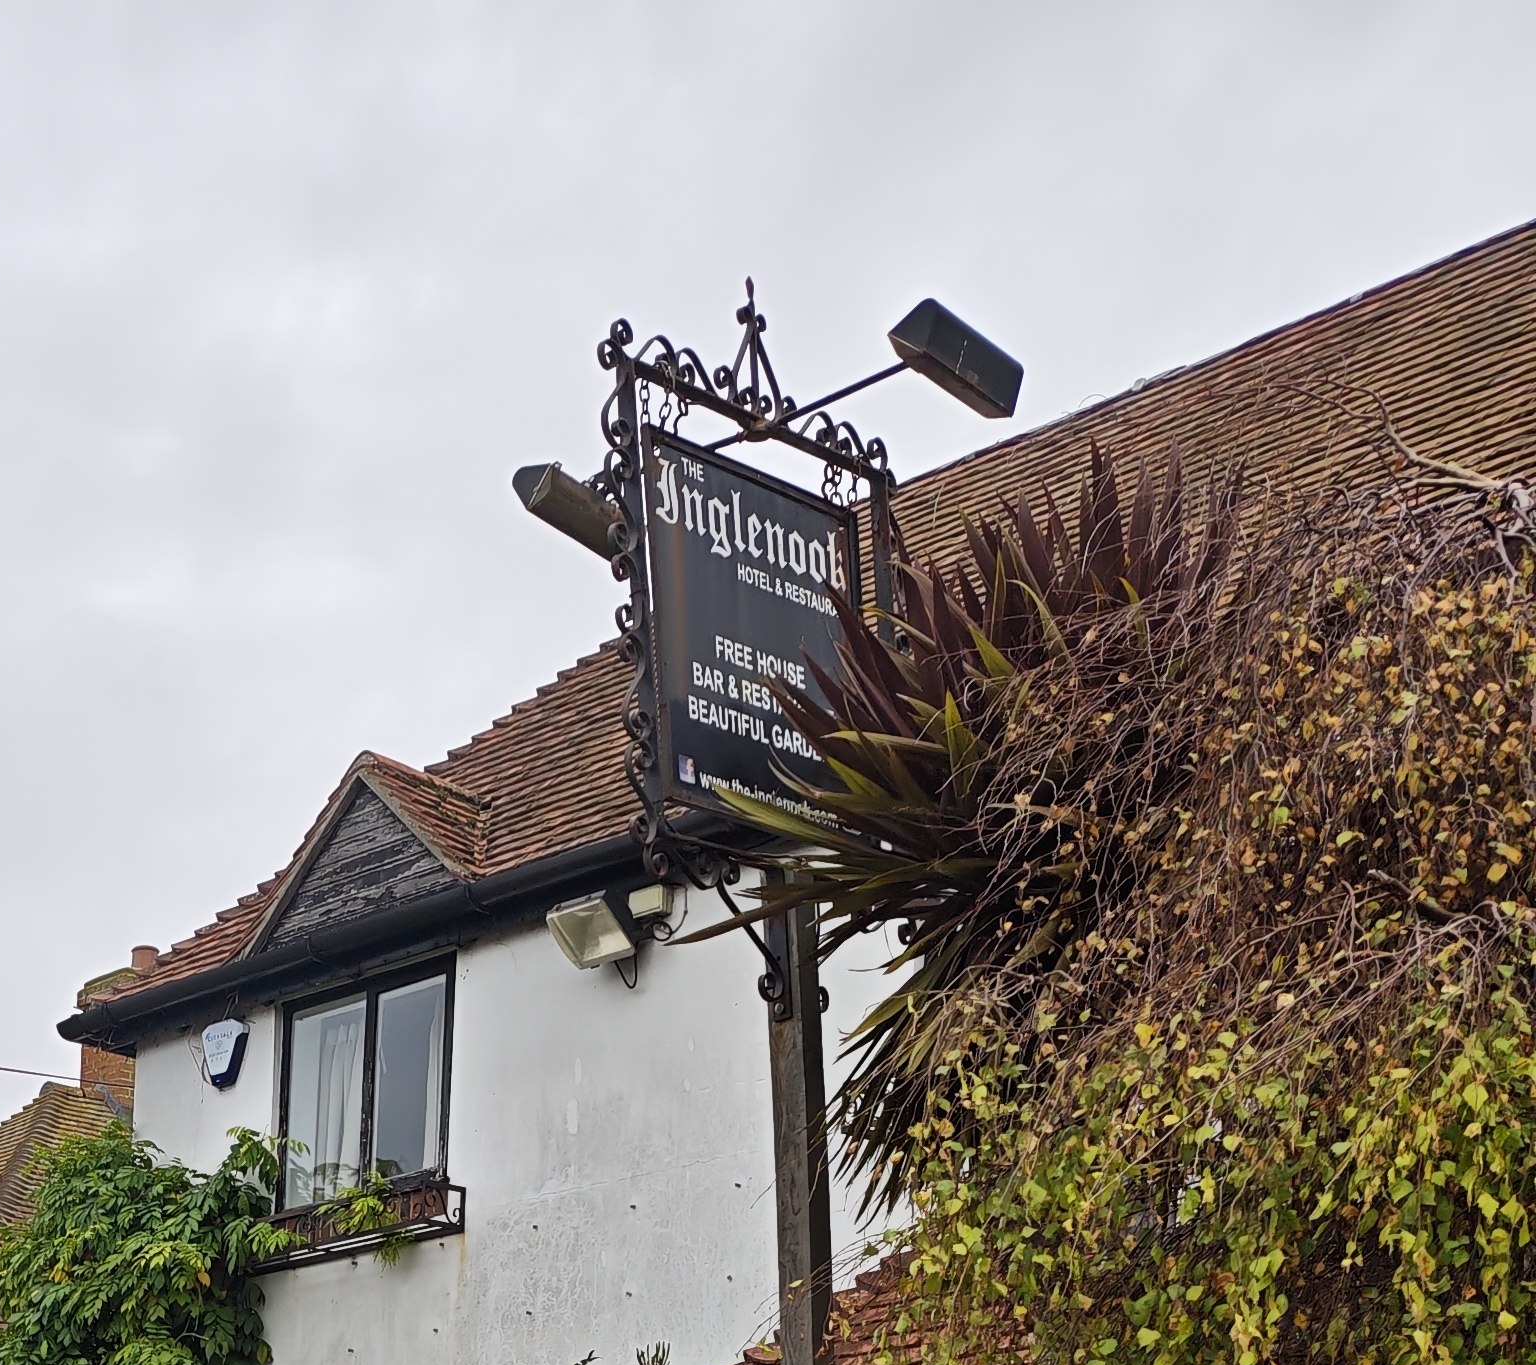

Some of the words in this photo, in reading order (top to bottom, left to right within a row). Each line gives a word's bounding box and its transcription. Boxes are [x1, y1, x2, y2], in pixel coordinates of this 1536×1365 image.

[681, 457, 704, 482] THE
[656, 458, 846, 591] Inglenook
[737, 563, 773, 593] HOTEL
[775, 577, 783, 596] &
[692, 661, 724, 695] BAR
[728, 674, 739, 700] &
[715, 635, 753, 671] FREE
[756, 650, 806, 690] HOUSE
[688, 695, 769, 744] BEAUTIFUL
